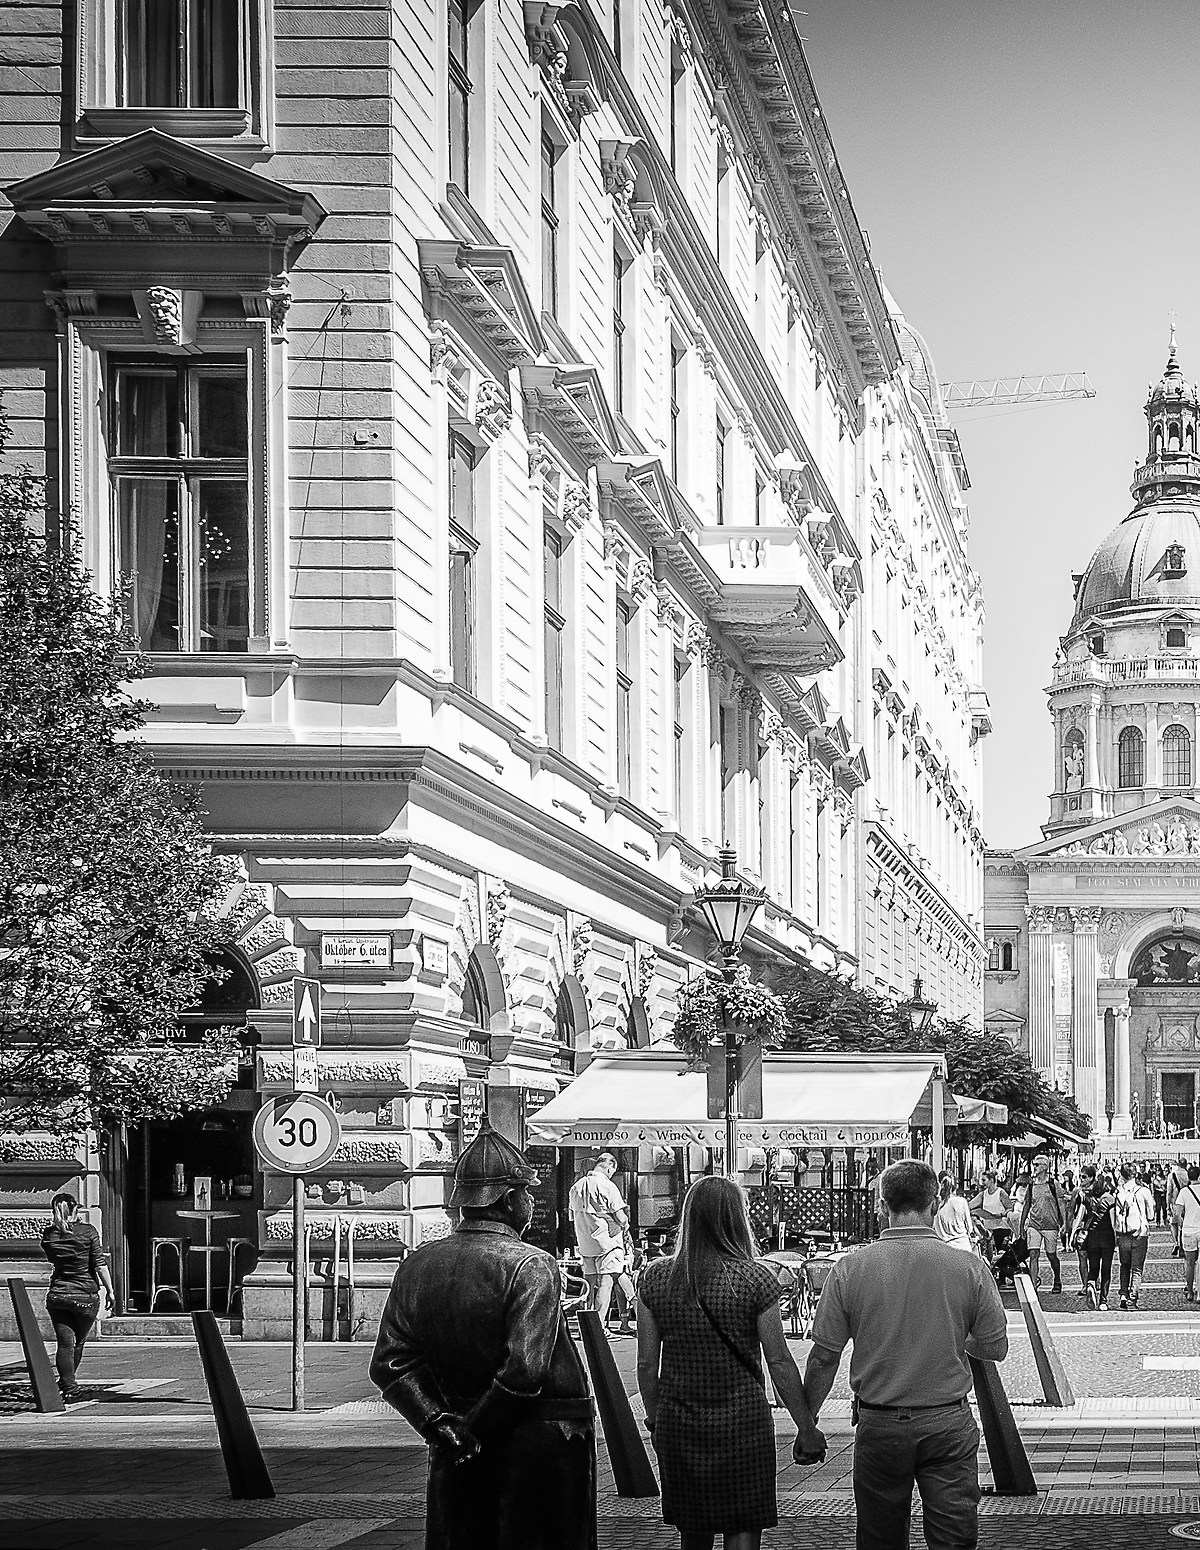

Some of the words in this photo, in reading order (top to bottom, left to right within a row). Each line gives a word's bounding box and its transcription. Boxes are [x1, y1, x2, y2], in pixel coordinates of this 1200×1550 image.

[1117, 877, 1141, 887] SUM
[325, 944, 357, 956] Október
[359, 943, 368, 956] 6.
[278, 1117, 317, 1147] 30
[656, 1130, 687, 1141] Wine
[779, 1130, 828, 1141] Cocktail
